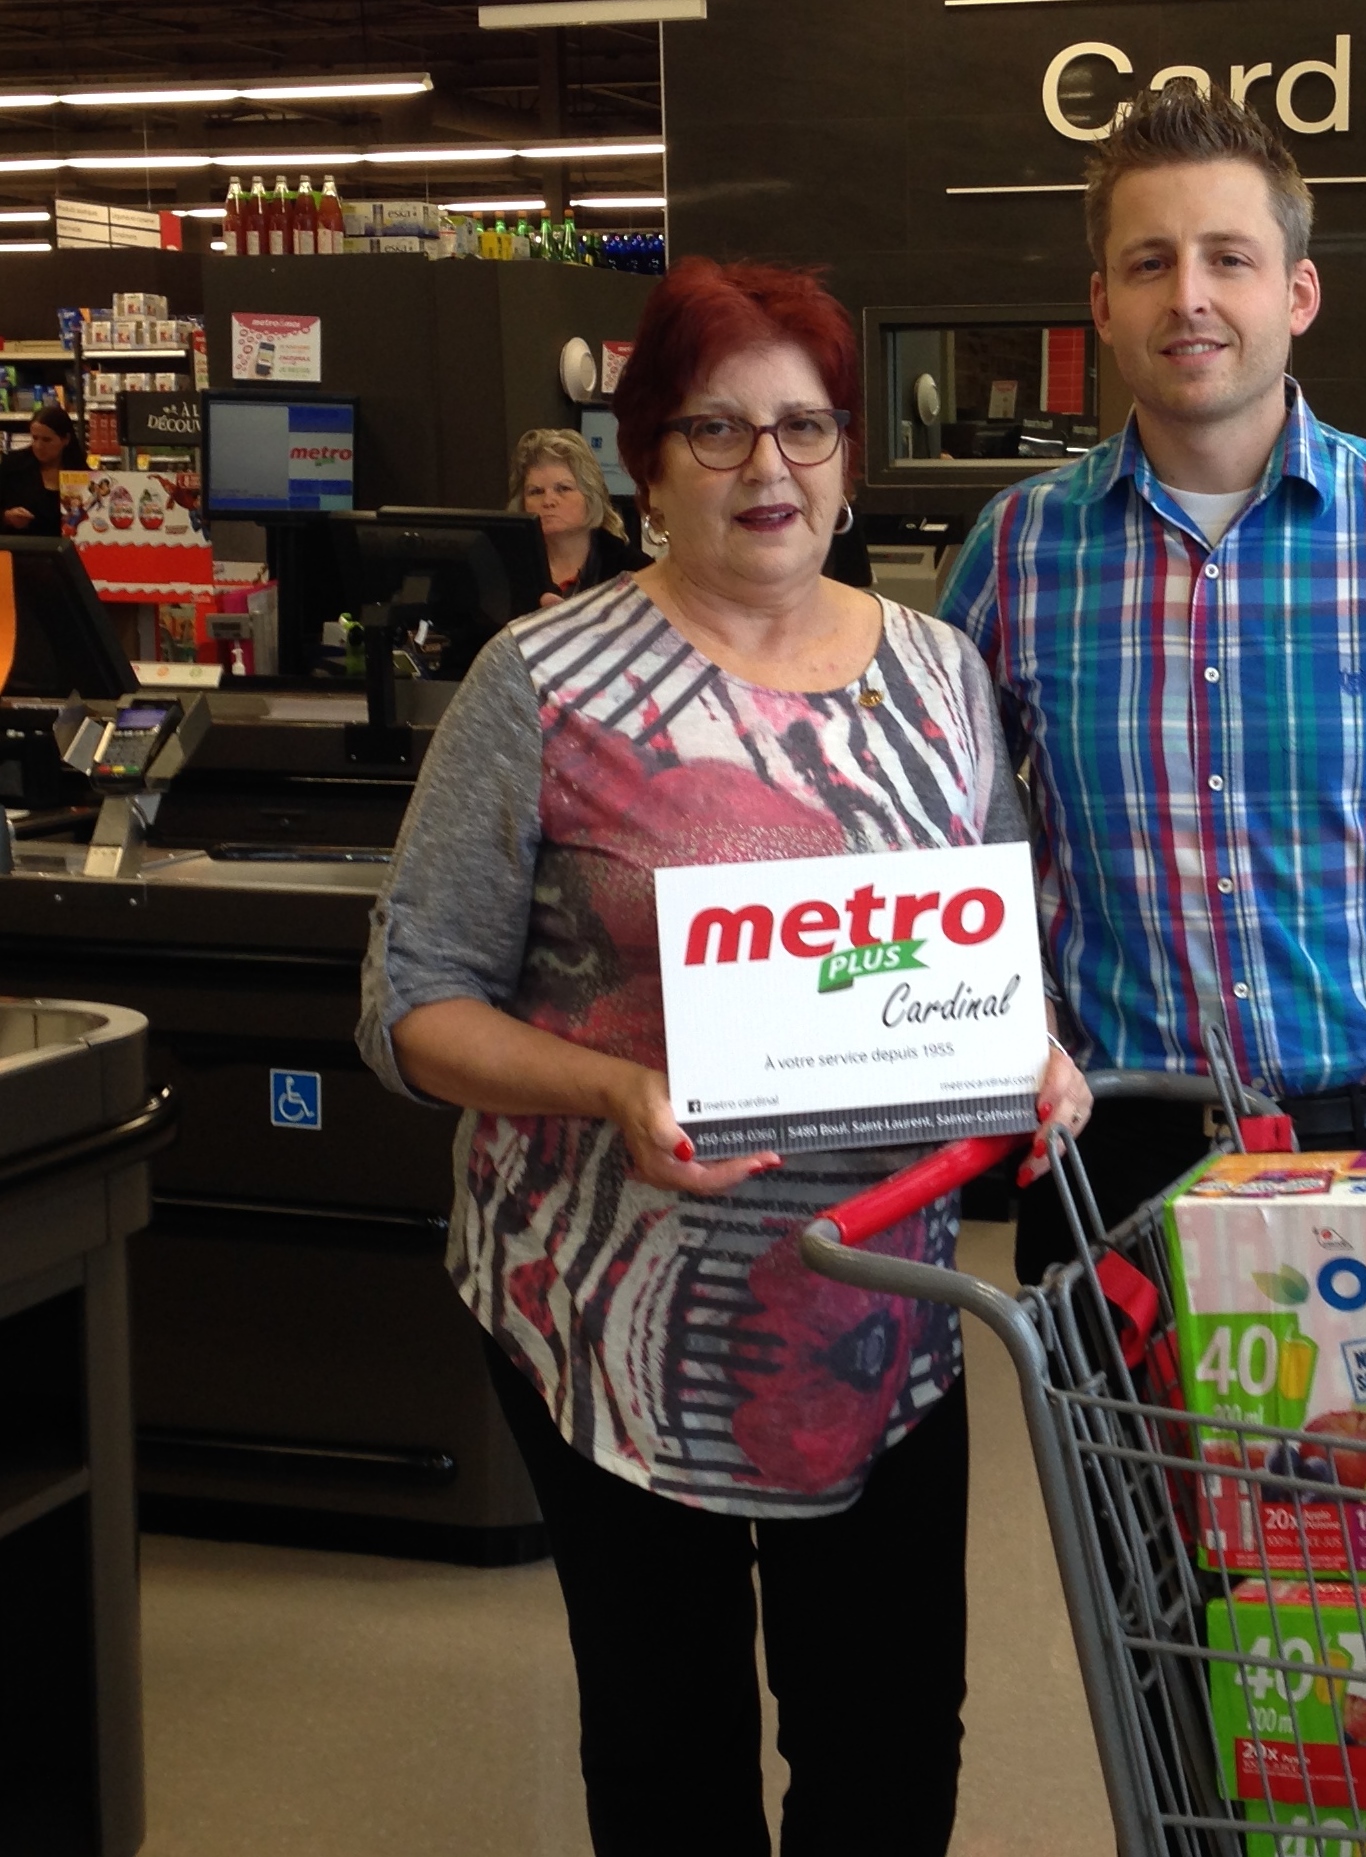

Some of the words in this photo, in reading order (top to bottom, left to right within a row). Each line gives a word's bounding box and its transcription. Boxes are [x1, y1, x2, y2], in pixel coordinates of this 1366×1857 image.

[289, 445, 353, 462] metro
[684, 881, 1006, 968] metro
[828, 945, 903, 981] PLUS
[881, 973, 1022, 1030] Cardinal
[778, 1054, 815, 1071] votre
[818, 1050, 868, 1068] service
[871, 1045, 919, 1065] depuis
[921, 1041, 956, 1059] 1955
[1195, 1323, 1278, 1397] 40
[1235, 1635, 1315, 1703] 40
